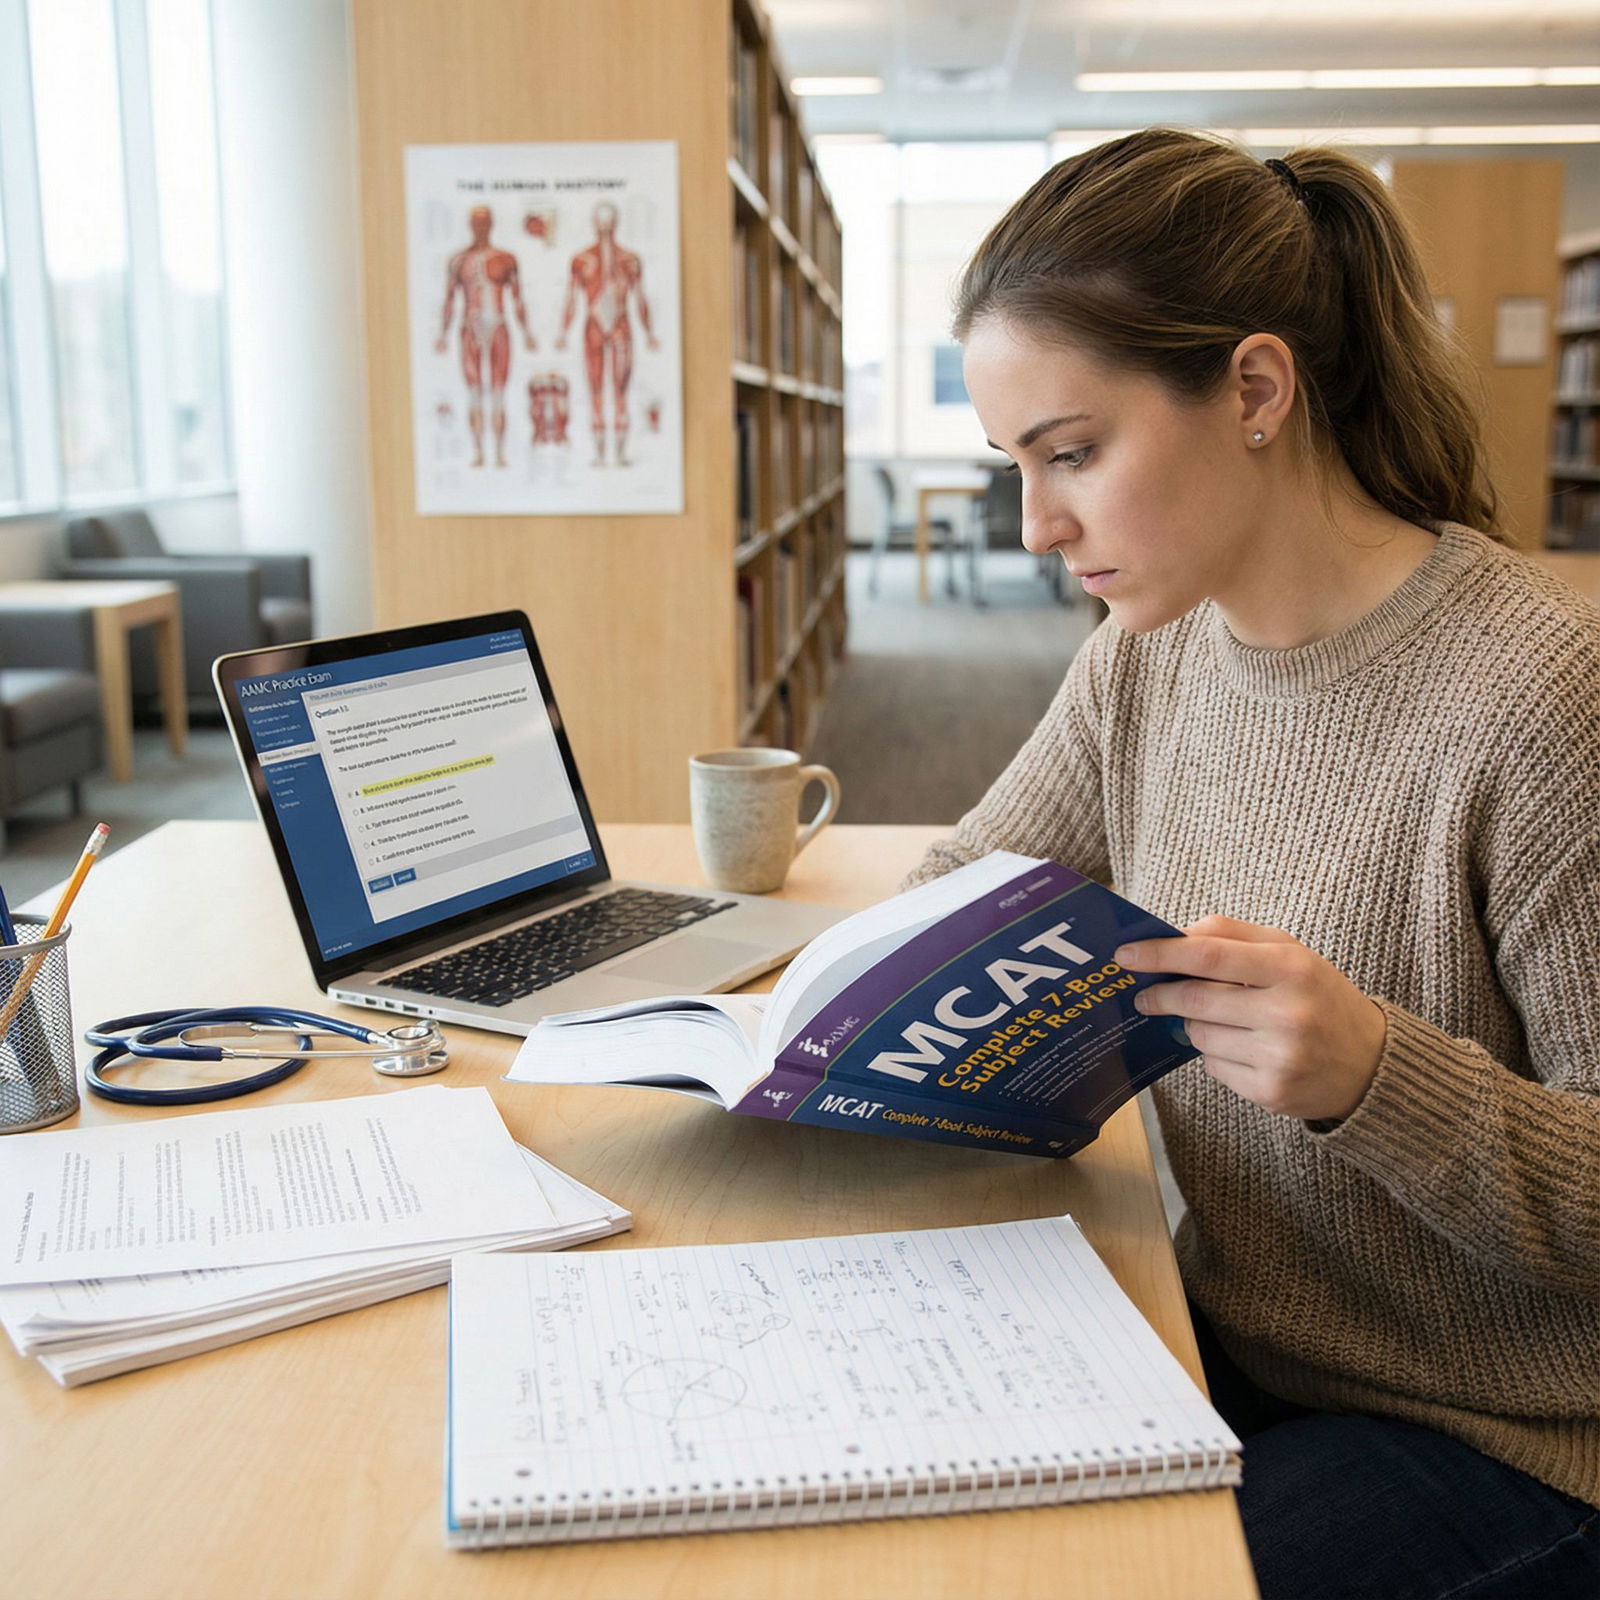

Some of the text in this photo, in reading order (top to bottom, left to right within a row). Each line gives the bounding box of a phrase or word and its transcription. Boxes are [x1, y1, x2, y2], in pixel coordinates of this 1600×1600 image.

[866, 921, 1094, 1083] MCAT
[938, 1006, 1046, 1087] Complete
[1041, 957, 1121, 1007] 7-Boo
[961, 1026, 1048, 1093] Subject
[1044, 974, 1137, 1029] Review
[817, 1094, 884, 1119] MCAT
[882, 1108, 929, 1126] Complete
[963, 1123, 1001, 1138] Subject
